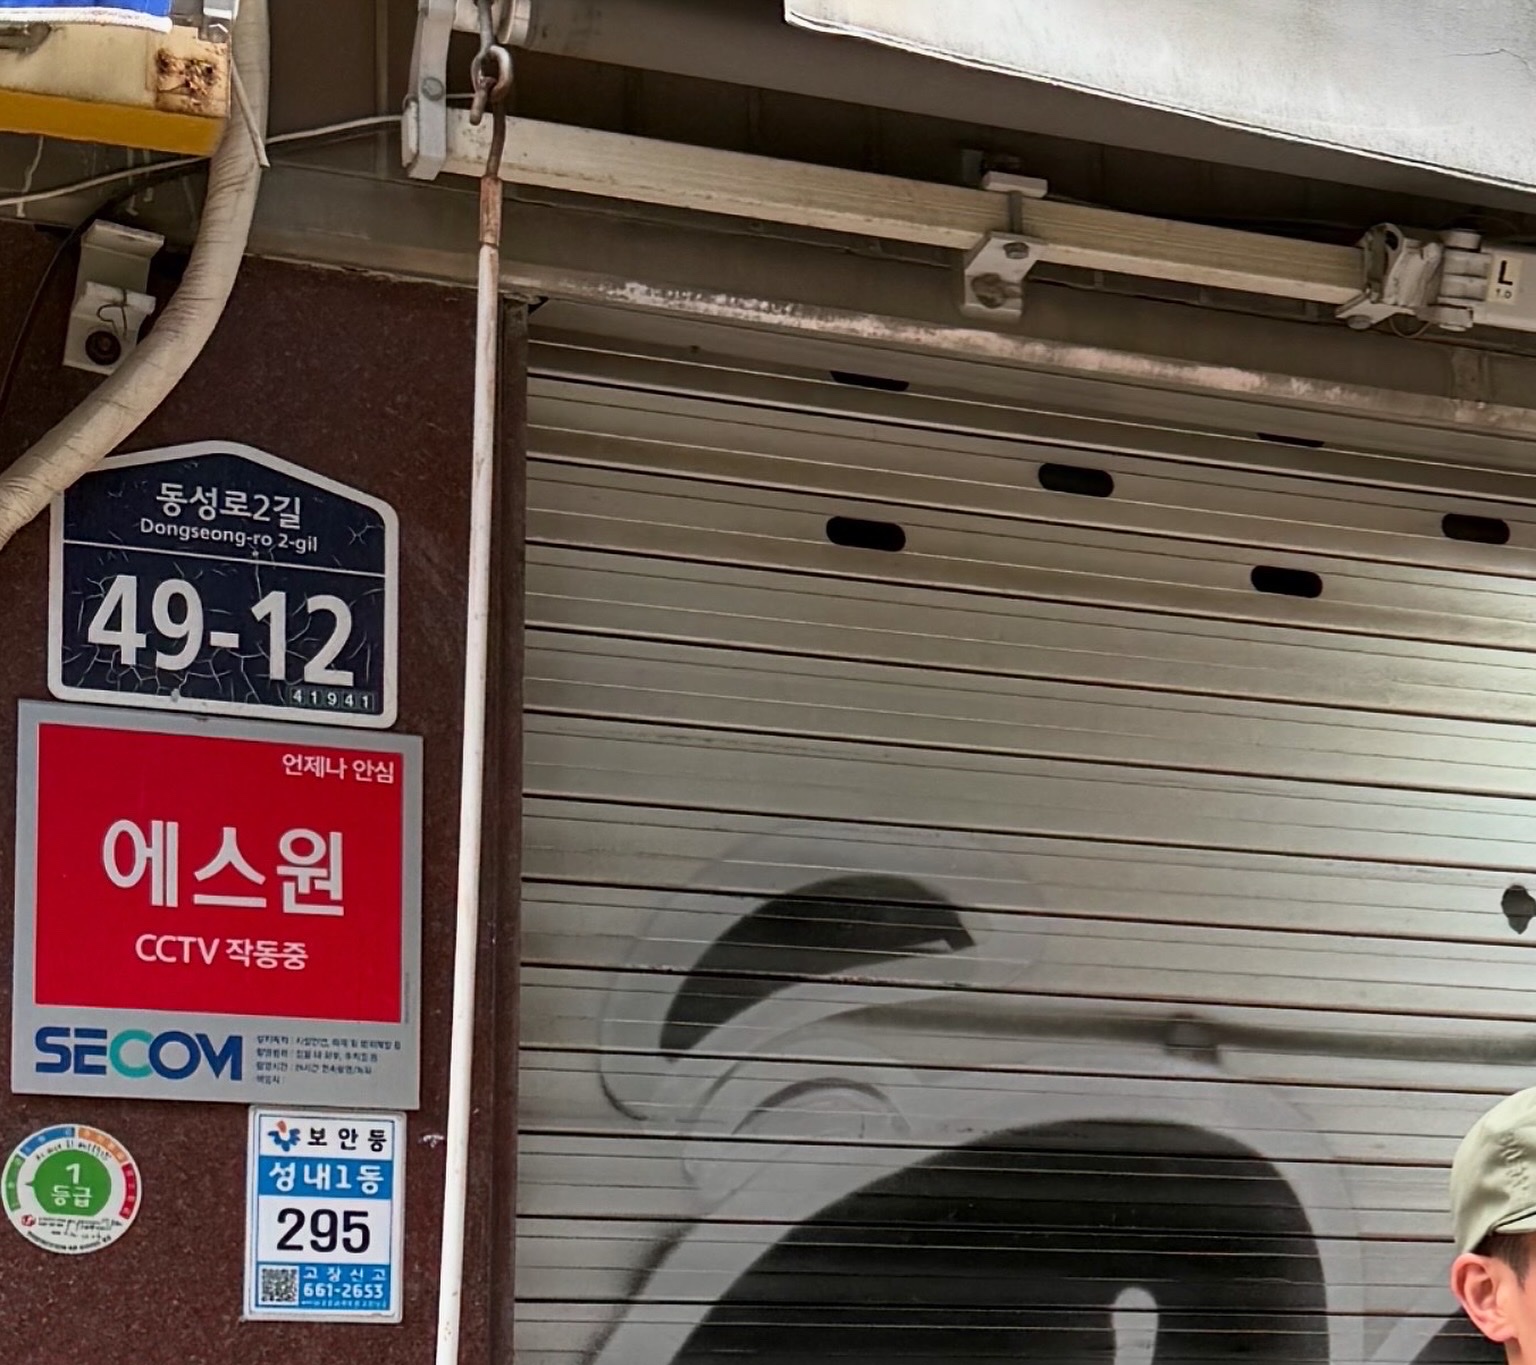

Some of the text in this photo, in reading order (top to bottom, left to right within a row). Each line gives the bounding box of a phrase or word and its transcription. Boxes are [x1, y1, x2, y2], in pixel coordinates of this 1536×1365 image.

[1497, 260, 1514, 286] L
[156, 483, 301, 530] 동성로2길
[140, 518, 318, 554] Dongseong-ro 2-gil
[87, 574, 355, 688] 49-12
[292, 689, 369, 709] 41941
[282, 754, 395, 785] 언제나 안심
[102, 819, 345, 917] 에스원
[135, 934, 310, 971] CCTV 작동중
[35, 1026, 244, 1082] SECOM
[307, 1126, 388, 1153] 보안등
[65, 1163, 81, 1185] 1
[268, 1161, 385, 1195] 성내1동
[51, 1184, 93, 1208] 등급
[276, 1207, 371, 1254] 295
[303, 1266, 387, 1283] 고장신고
[303, 1283, 384, 1299] 661-2653
